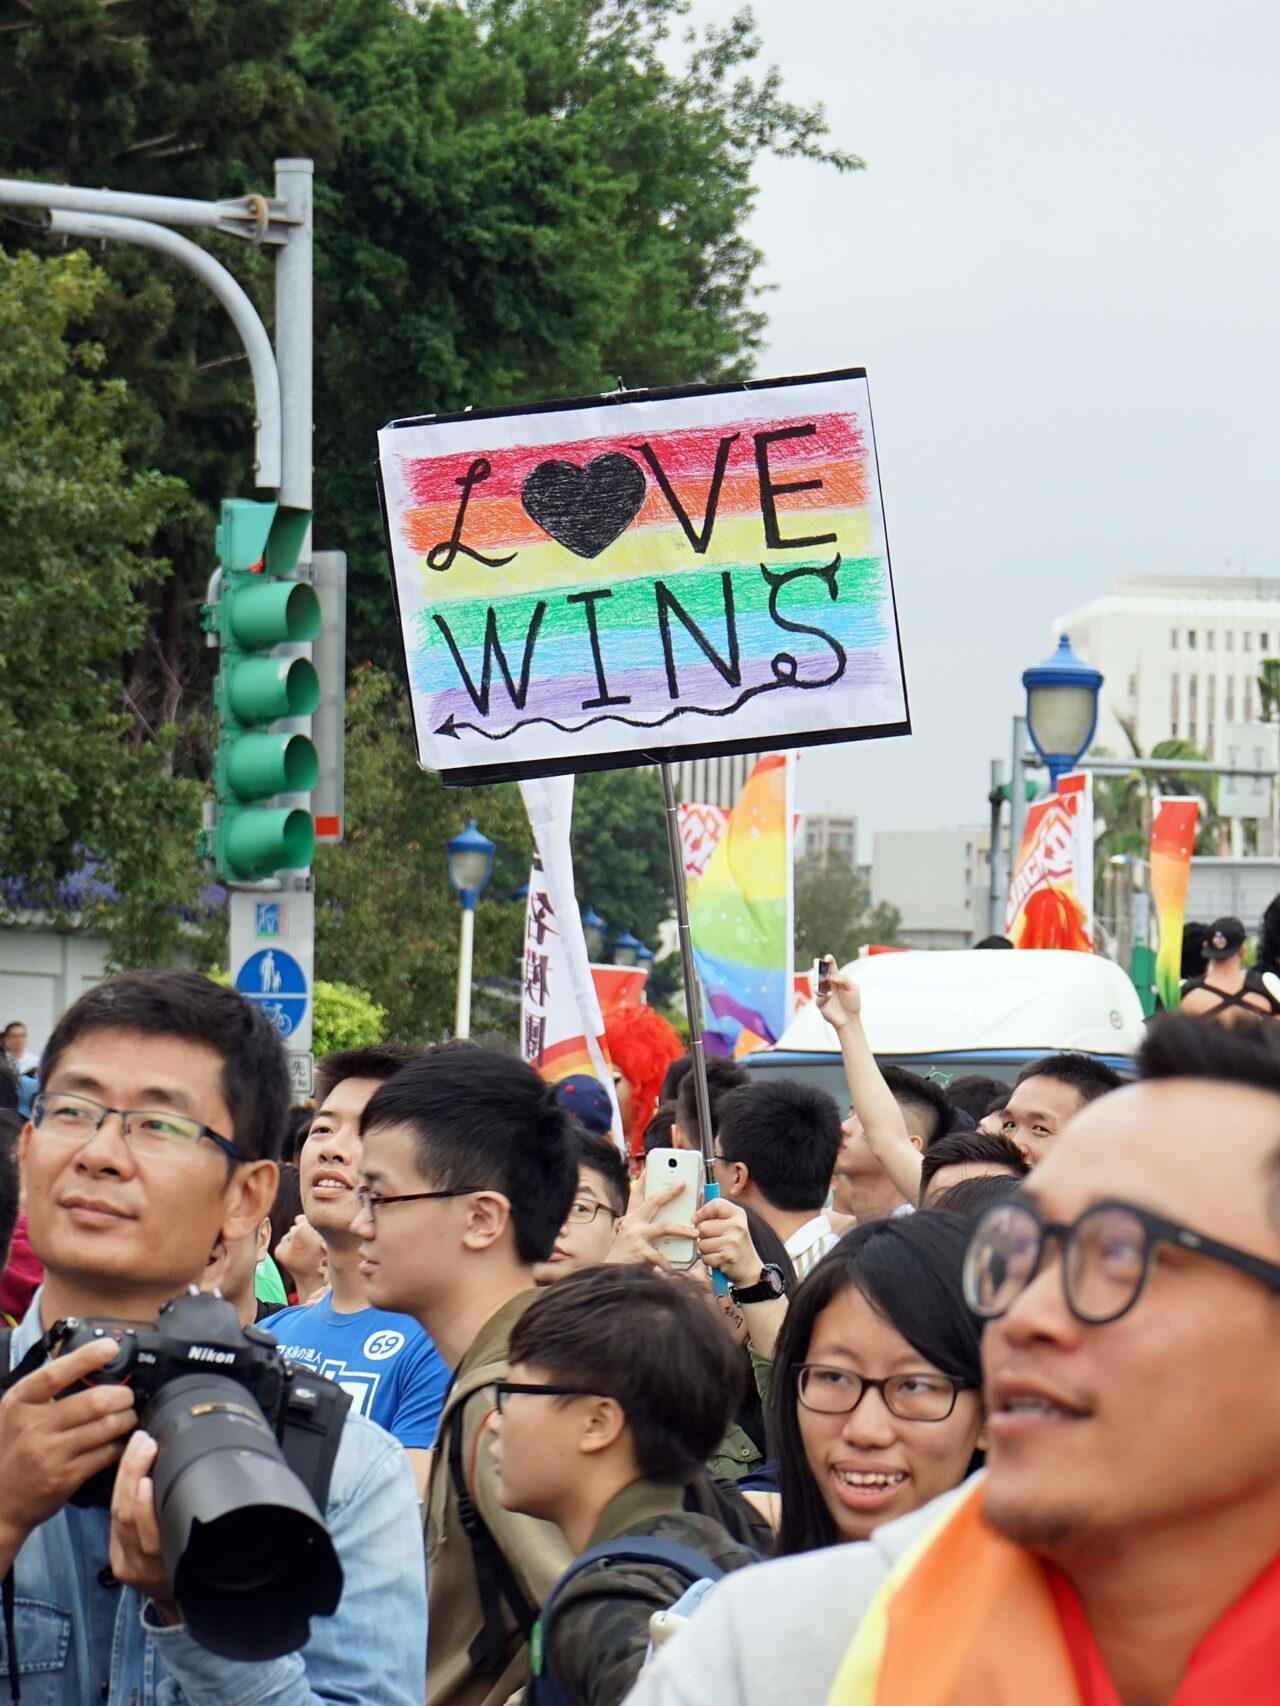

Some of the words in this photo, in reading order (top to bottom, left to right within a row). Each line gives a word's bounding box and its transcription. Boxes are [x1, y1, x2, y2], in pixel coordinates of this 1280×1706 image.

[433, 552, 846, 718] WINS
[187, 1345, 236, 1365] Nikon
[368, 1334, 399, 1355] 69
